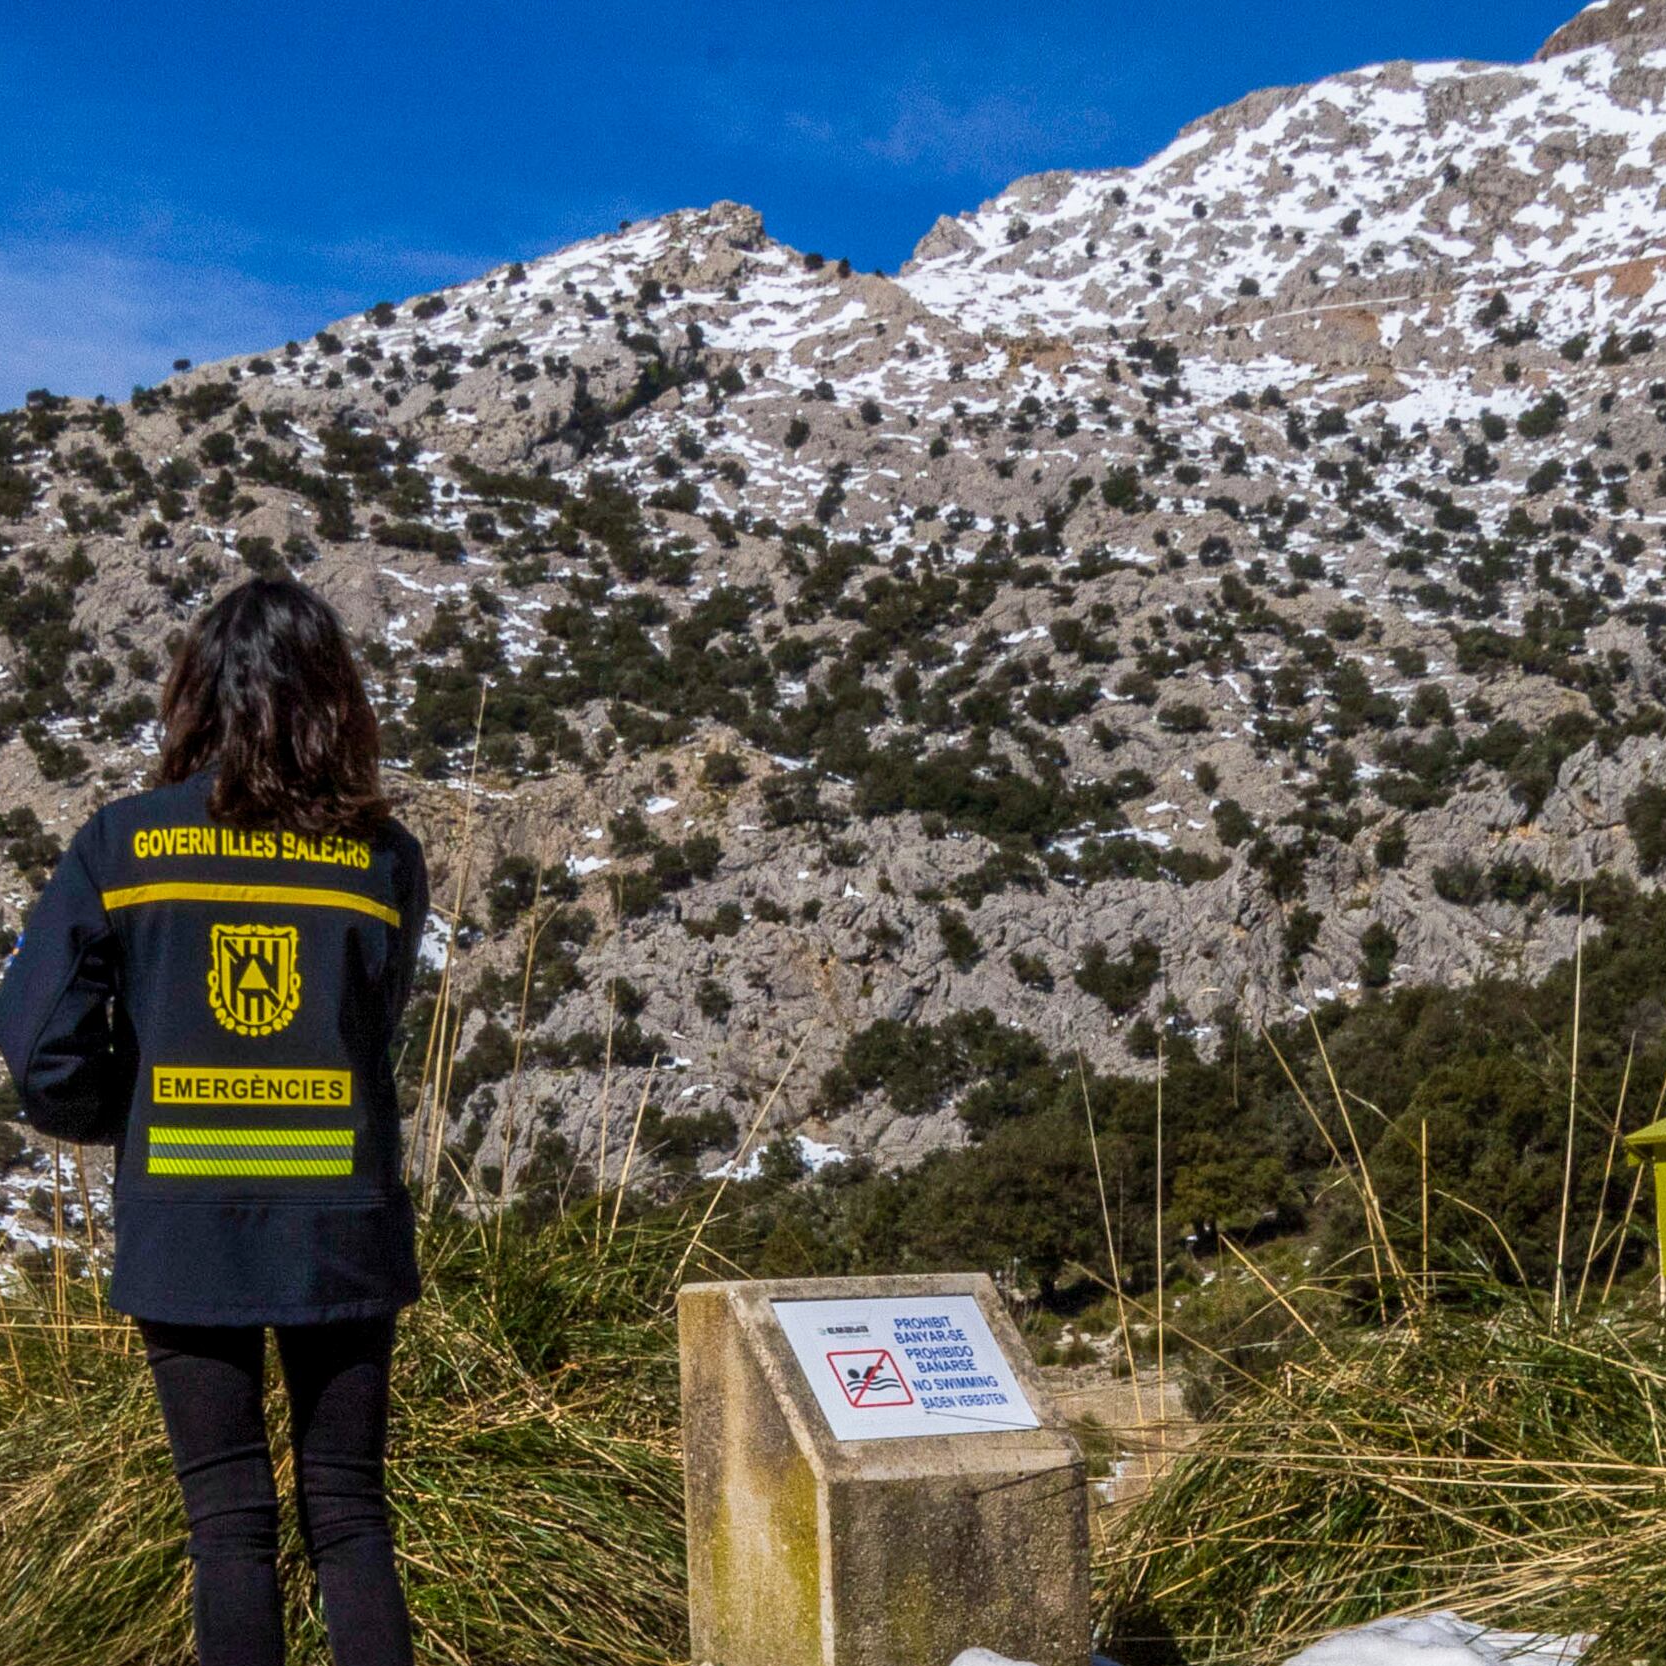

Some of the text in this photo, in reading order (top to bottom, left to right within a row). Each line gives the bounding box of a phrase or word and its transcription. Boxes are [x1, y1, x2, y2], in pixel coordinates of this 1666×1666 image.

[134, 827, 370, 869] GOVERN ILLES BALEARS
[159, 1074, 344, 1100] EMERGÈNCIES
[894, 1316, 952, 1330] PROHIBIT
[894, 1329, 967, 1344] BANYAR-SE
[905, 1345, 974, 1360] PROHIBIDO
[912, 1376, 999, 1391] NO SWIMMING
[920, 1393, 1008, 1409] BADEN VERBOTEN
